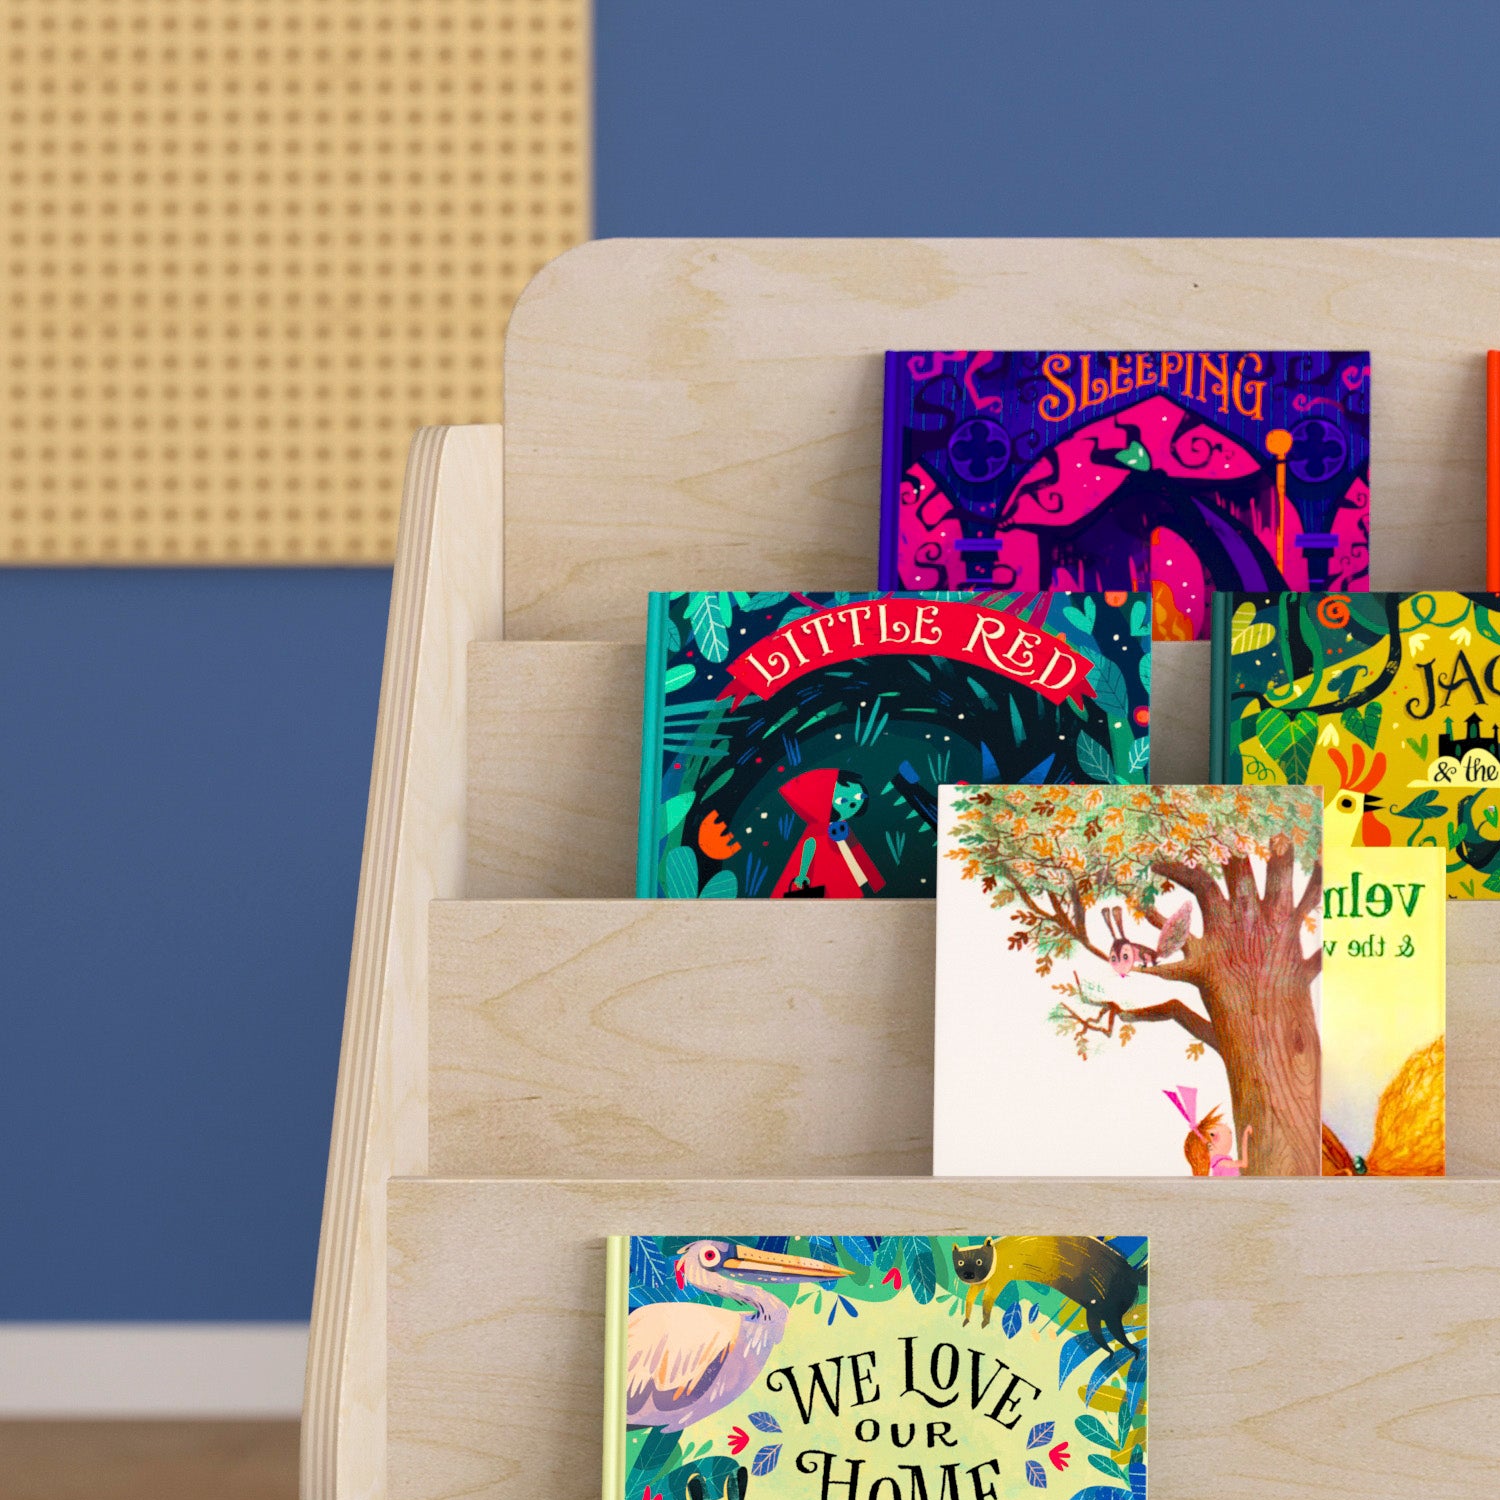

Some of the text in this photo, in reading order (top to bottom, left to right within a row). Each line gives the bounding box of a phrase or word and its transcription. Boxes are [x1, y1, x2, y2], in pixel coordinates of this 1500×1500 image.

[1038, 351, 1267, 422] SLEEPING
[745, 604, 1079, 690] LITTLE RED
[1433, 755, 1499, 783] & the
[766, 1336, 1042, 1430] WE LOVE
[854, 1416, 959, 1448] OUR
